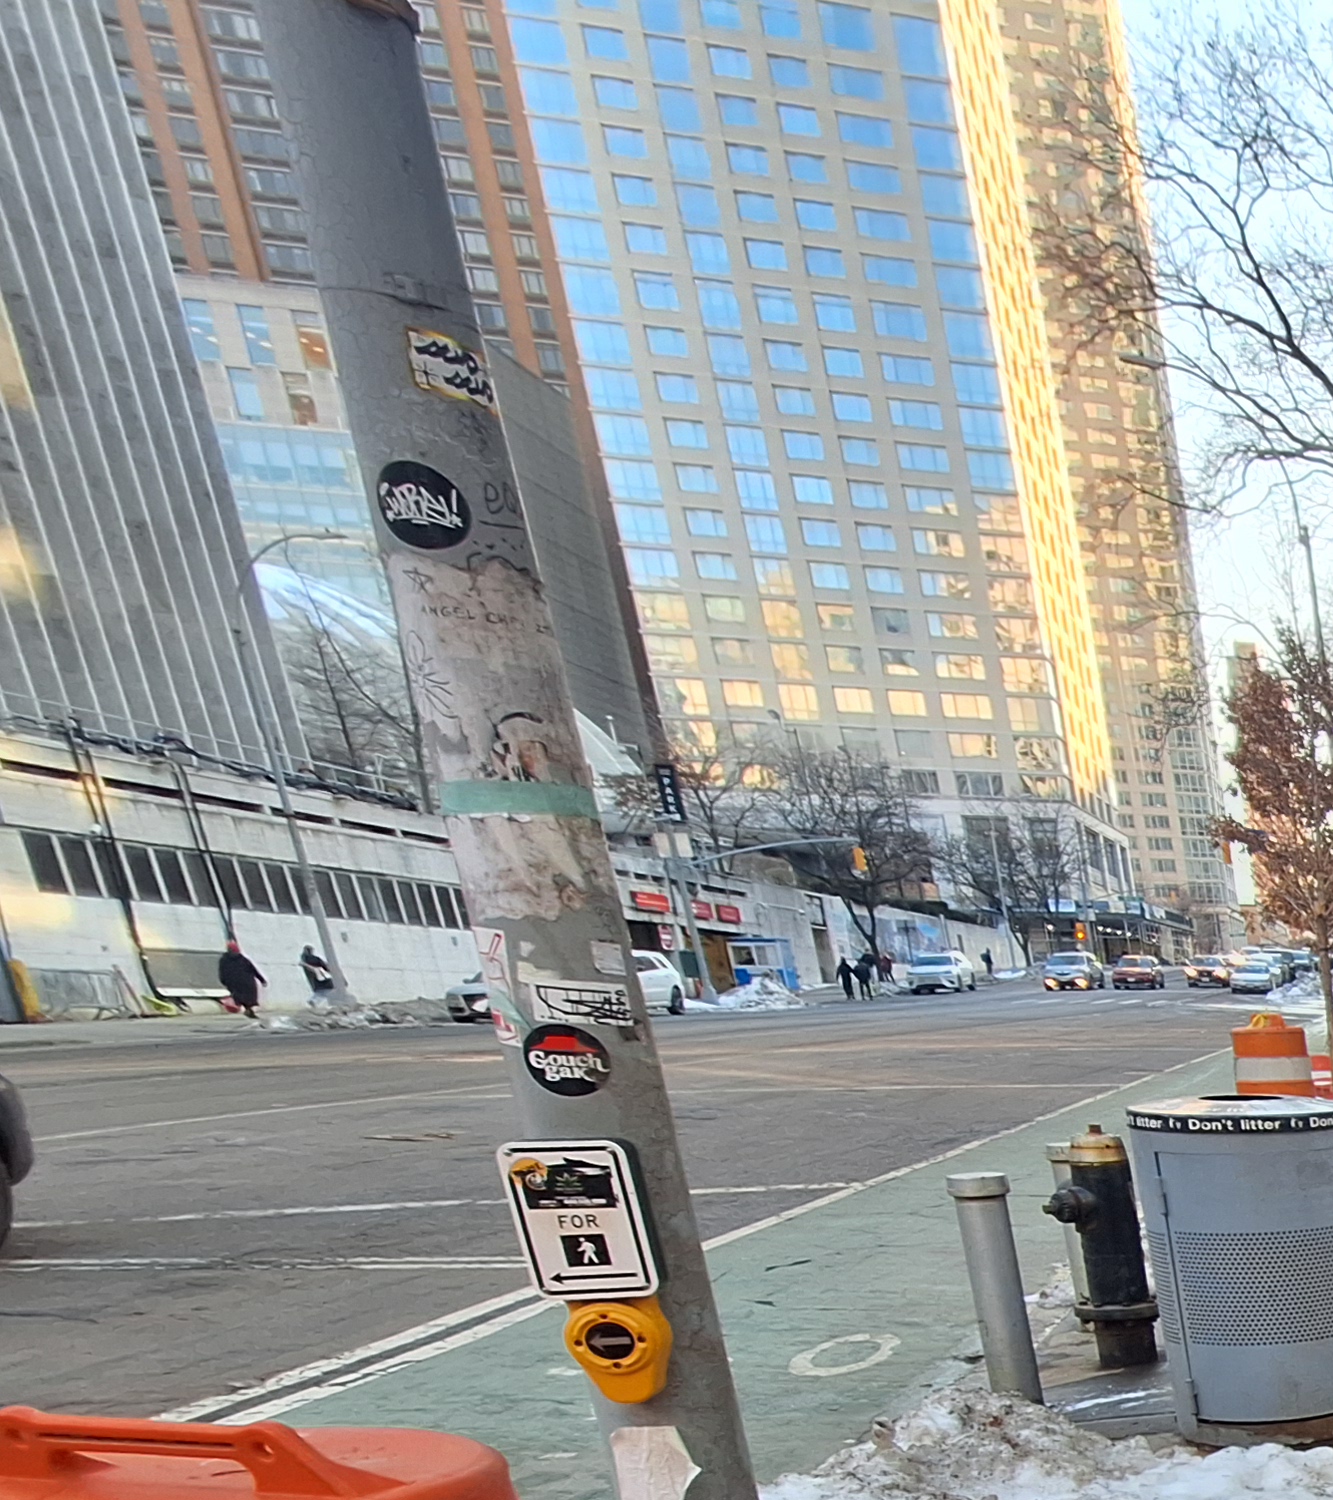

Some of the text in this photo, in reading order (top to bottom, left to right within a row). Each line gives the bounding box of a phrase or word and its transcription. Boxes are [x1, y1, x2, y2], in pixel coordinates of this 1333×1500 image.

[1188, 1119, 1234, 1131] Don't
[1241, 1118, 1282, 1130] litter
[557, 1214, 600, 1229] FOR
